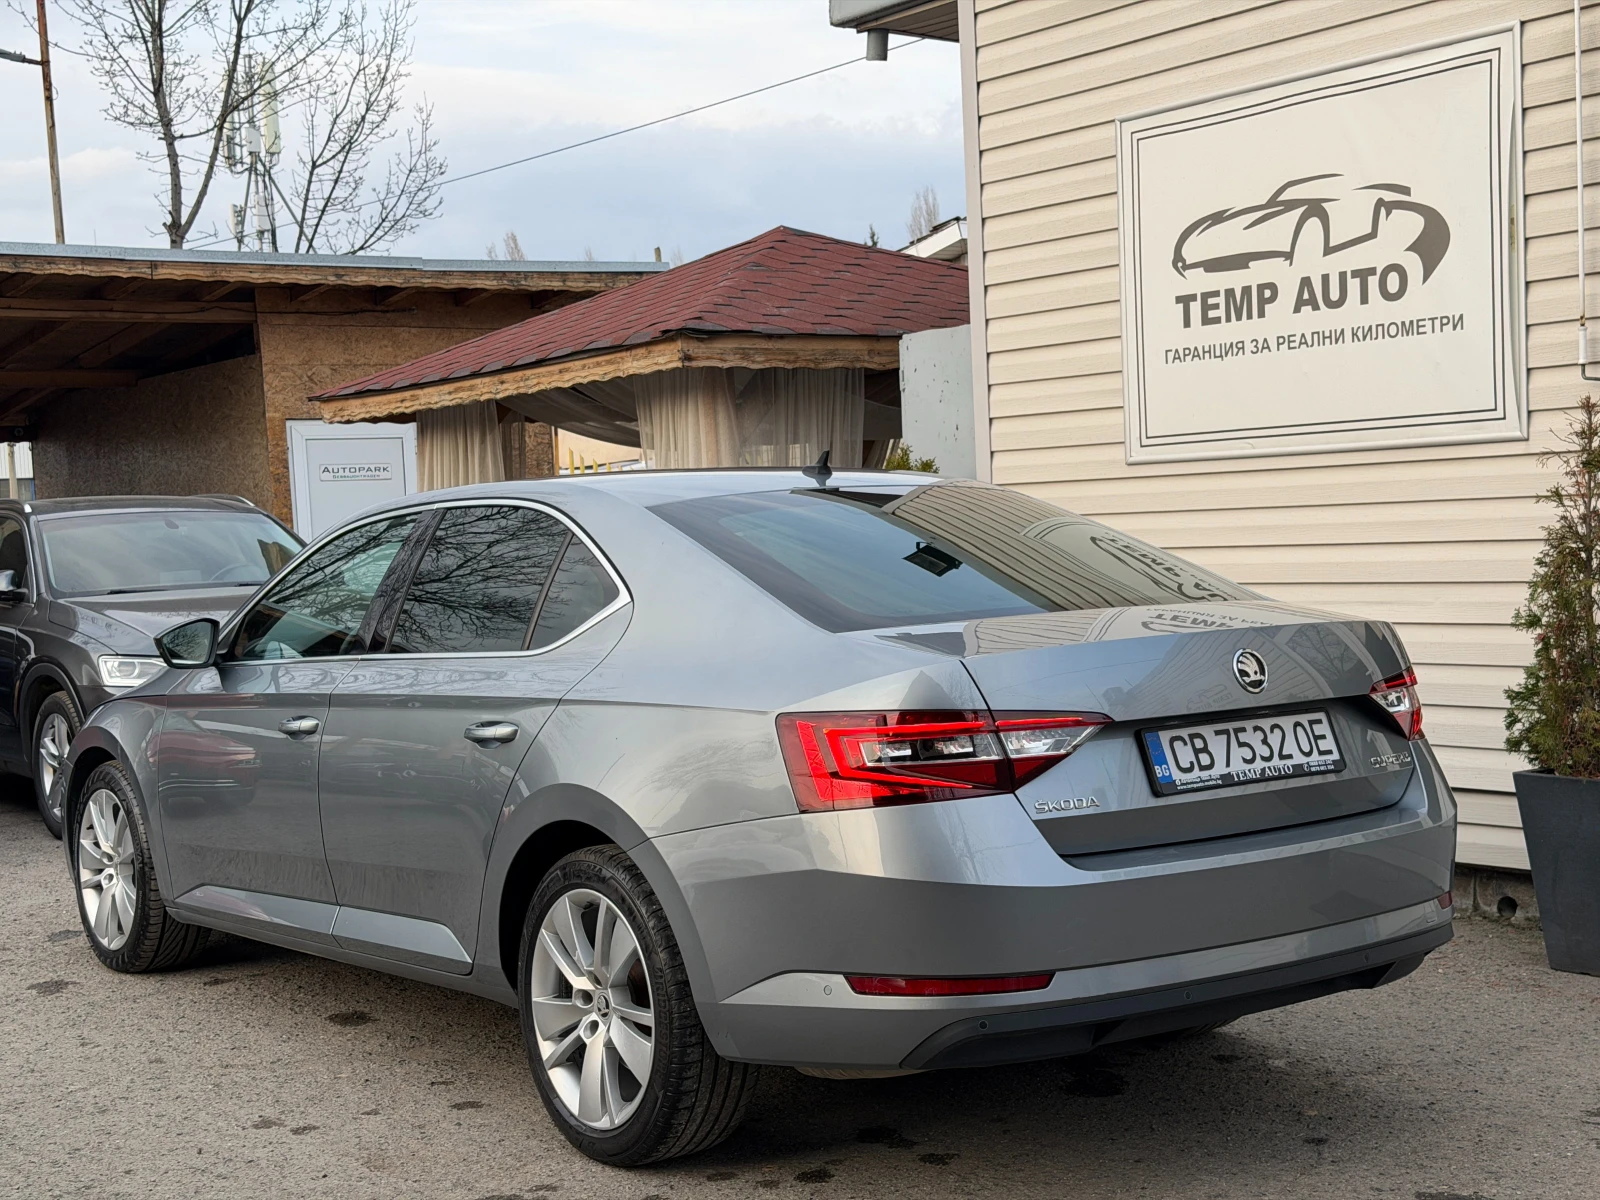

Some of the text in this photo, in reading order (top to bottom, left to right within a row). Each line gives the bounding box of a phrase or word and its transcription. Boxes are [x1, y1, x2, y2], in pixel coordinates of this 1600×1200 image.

[1175, 262, 1409, 329] TEMP AUTO
[1164, 313, 1465, 365] ГАРАНЦИЯ ЗА РЕАЛНИ КИЛОМЕТРИ
[1213, 722, 1294, 769] 7532
[1155, 764, 1170, 778] BG
[1231, 768, 1262, 782] TEMP
[1264, 764, 1293, 777] AUTO
[1034, 796, 1100, 814] ŠKODA
